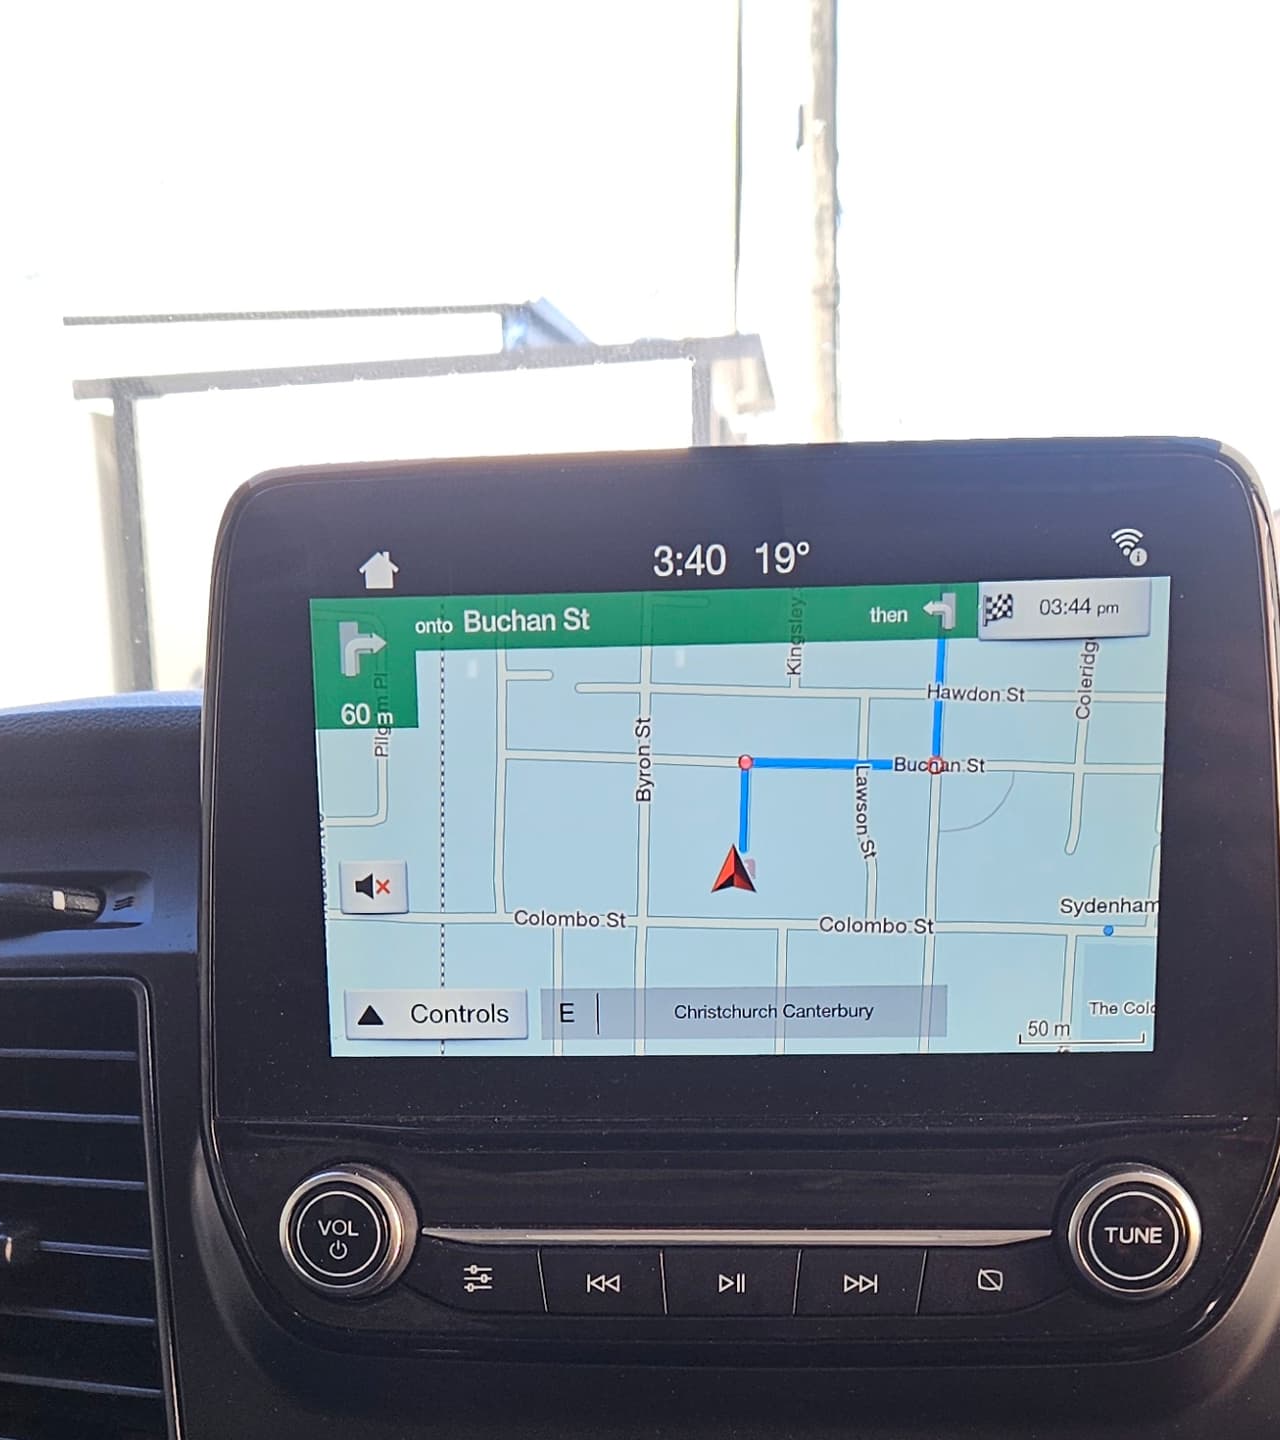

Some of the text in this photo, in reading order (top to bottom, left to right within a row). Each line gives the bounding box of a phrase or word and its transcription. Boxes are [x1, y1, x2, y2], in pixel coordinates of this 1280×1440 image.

[652, 544, 727, 577] 3:40
[755, 541, 811, 574] 19°
[870, 606, 909, 623] then
[1039, 597, 1119, 618] 03:44 pm
[415, 607, 590, 634] onto Buchan St
[1075, 640, 1100, 720] Coleridg
[926, 682, 1025, 703] Hawdon St
[341, 703, 393, 725] 60 m
[635, 716, 653, 802] Byron St
[894, 756, 985, 775] Buchan St
[855, 765, 877, 860] Lawson St
[514, 909, 627, 928] Colombo St
[819, 916, 935, 935] Colombo St
[410, 1002, 509, 1025] Controls
[560, 1002, 874, 1023] E Christchurch Canterbury
[1089, 1001, 1118, 1016] The
[1028, 1020, 1070, 1037] 50 m
[317, 1219, 360, 1237] VOL
[1103, 1226, 1163, 1244] TUNE
